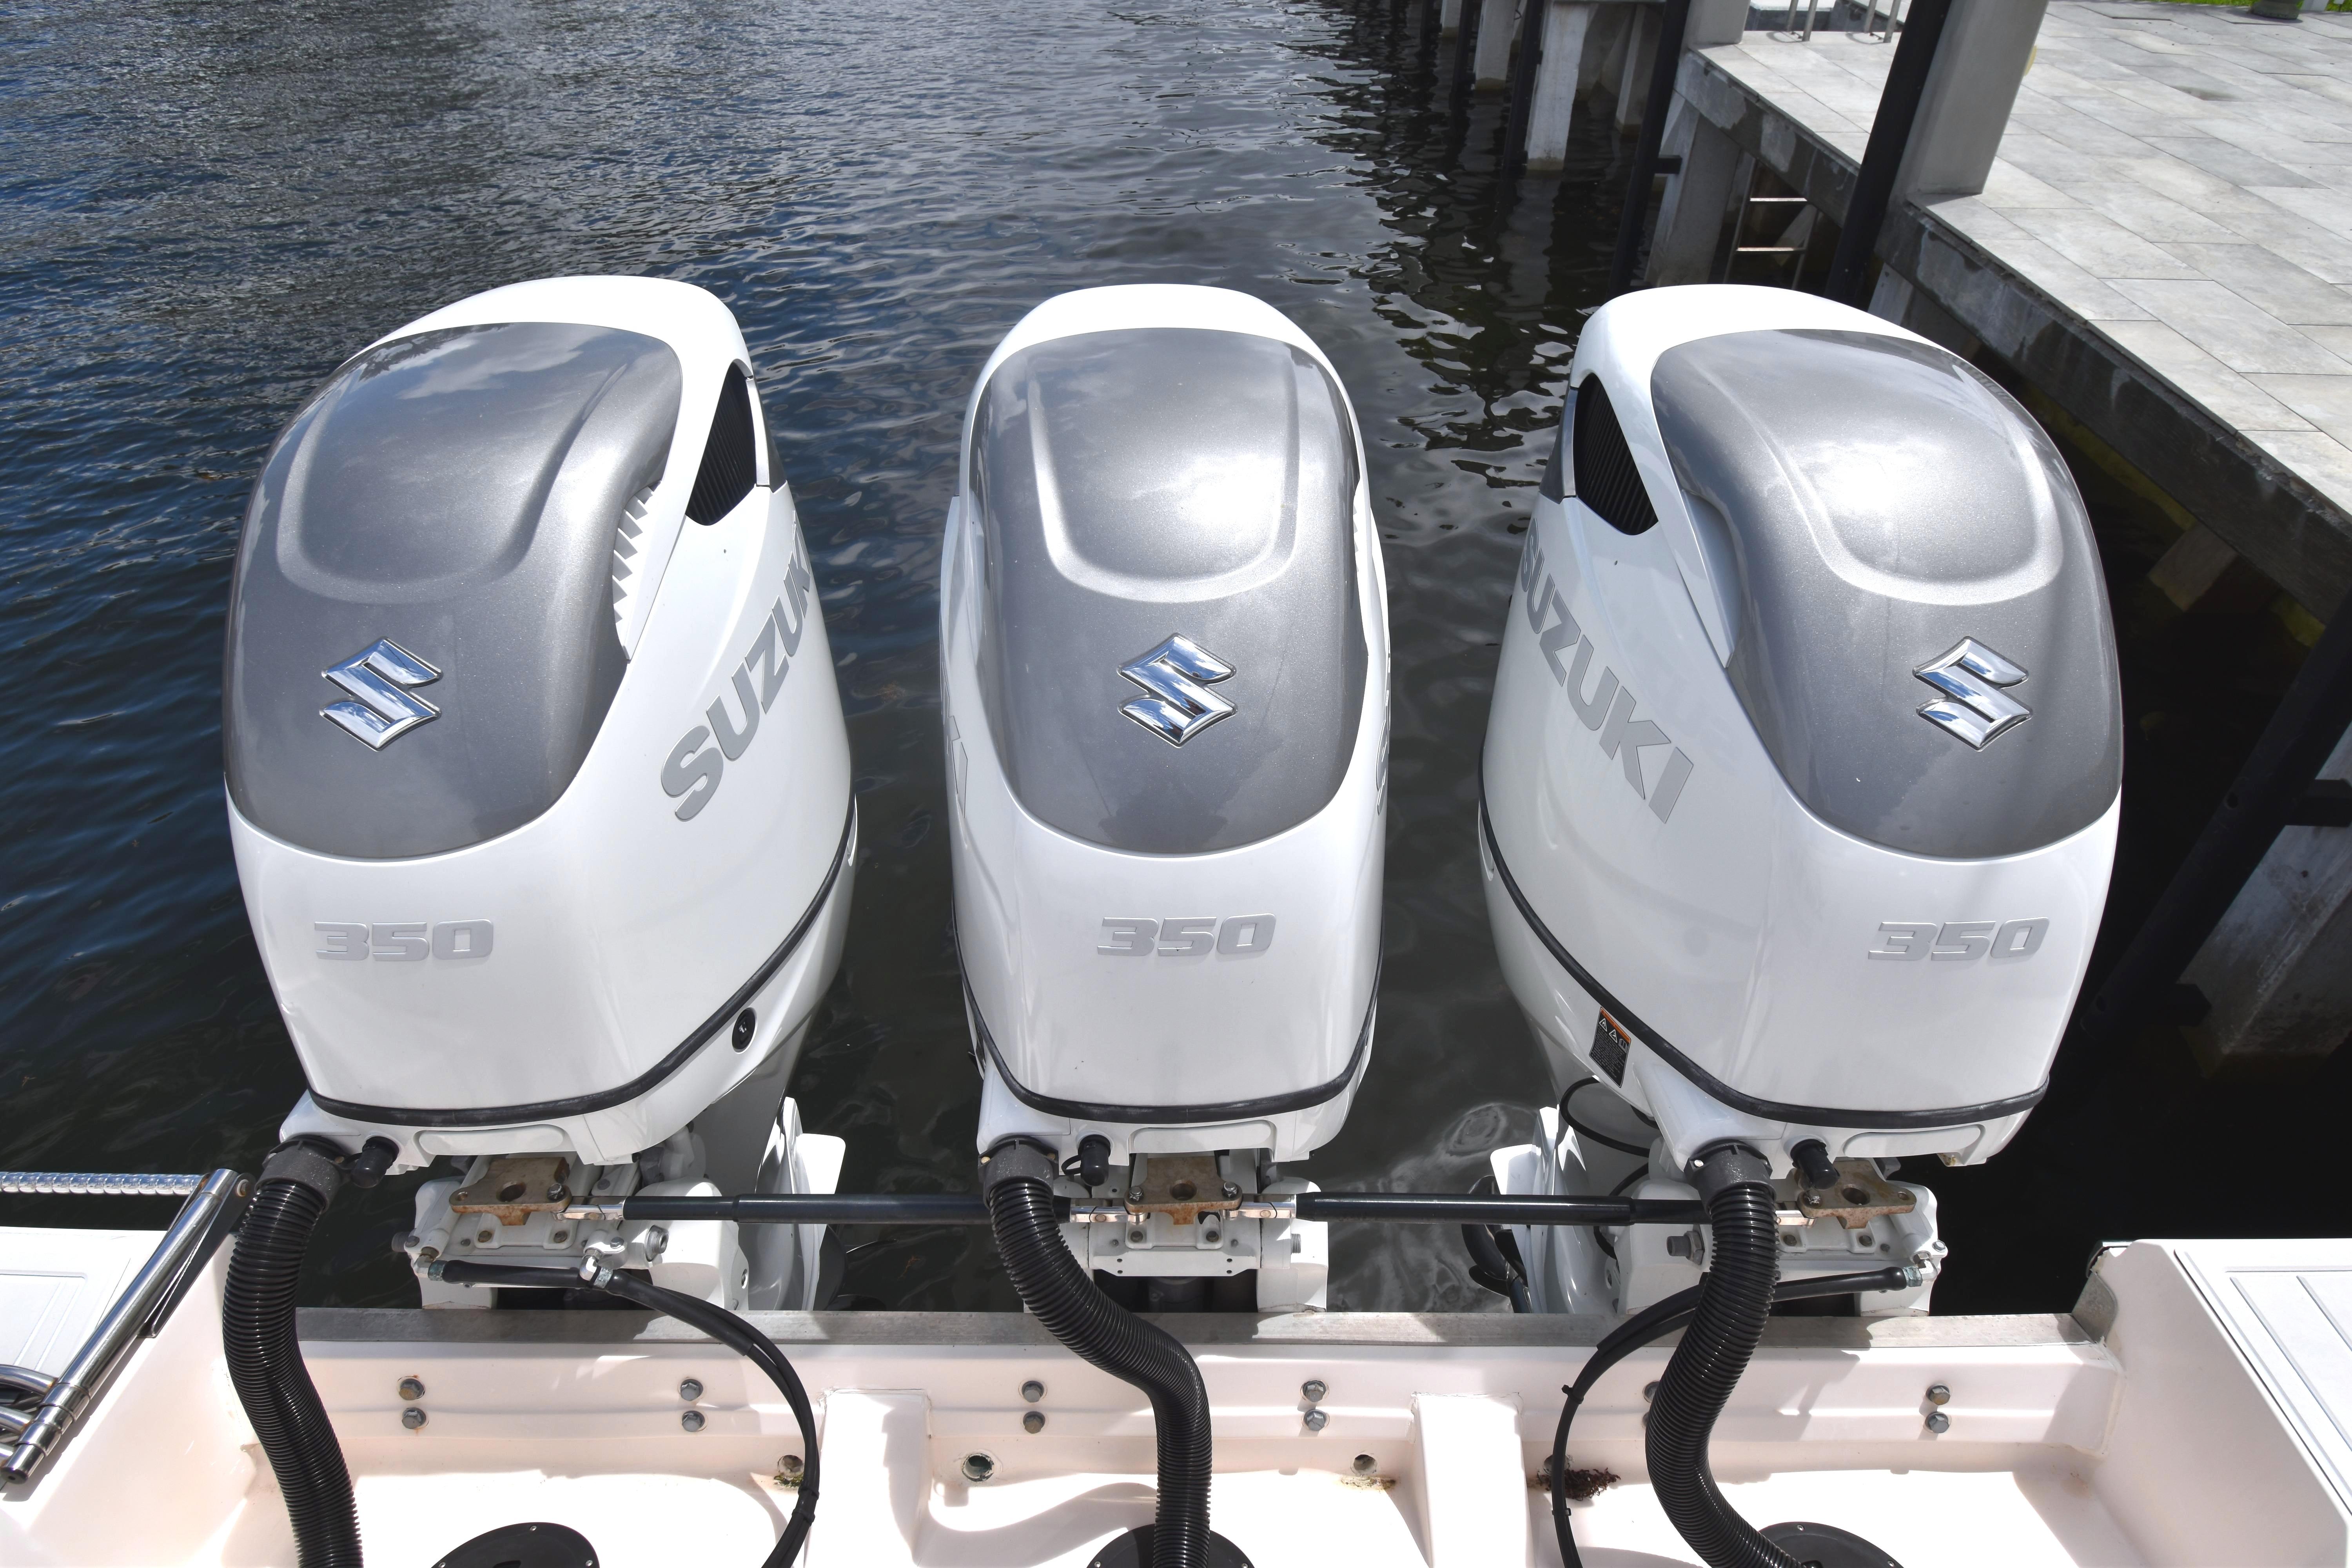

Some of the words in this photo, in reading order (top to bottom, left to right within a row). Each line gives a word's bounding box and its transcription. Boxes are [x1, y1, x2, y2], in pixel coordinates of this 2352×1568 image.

[661, 510, 811, 822] SUZUK
[1521, 517, 1694, 824] SUZUKI
[315, 919, 493, 961] 350
[1097, 913, 1276, 956] 350
[1868, 916, 2050, 961] 350
